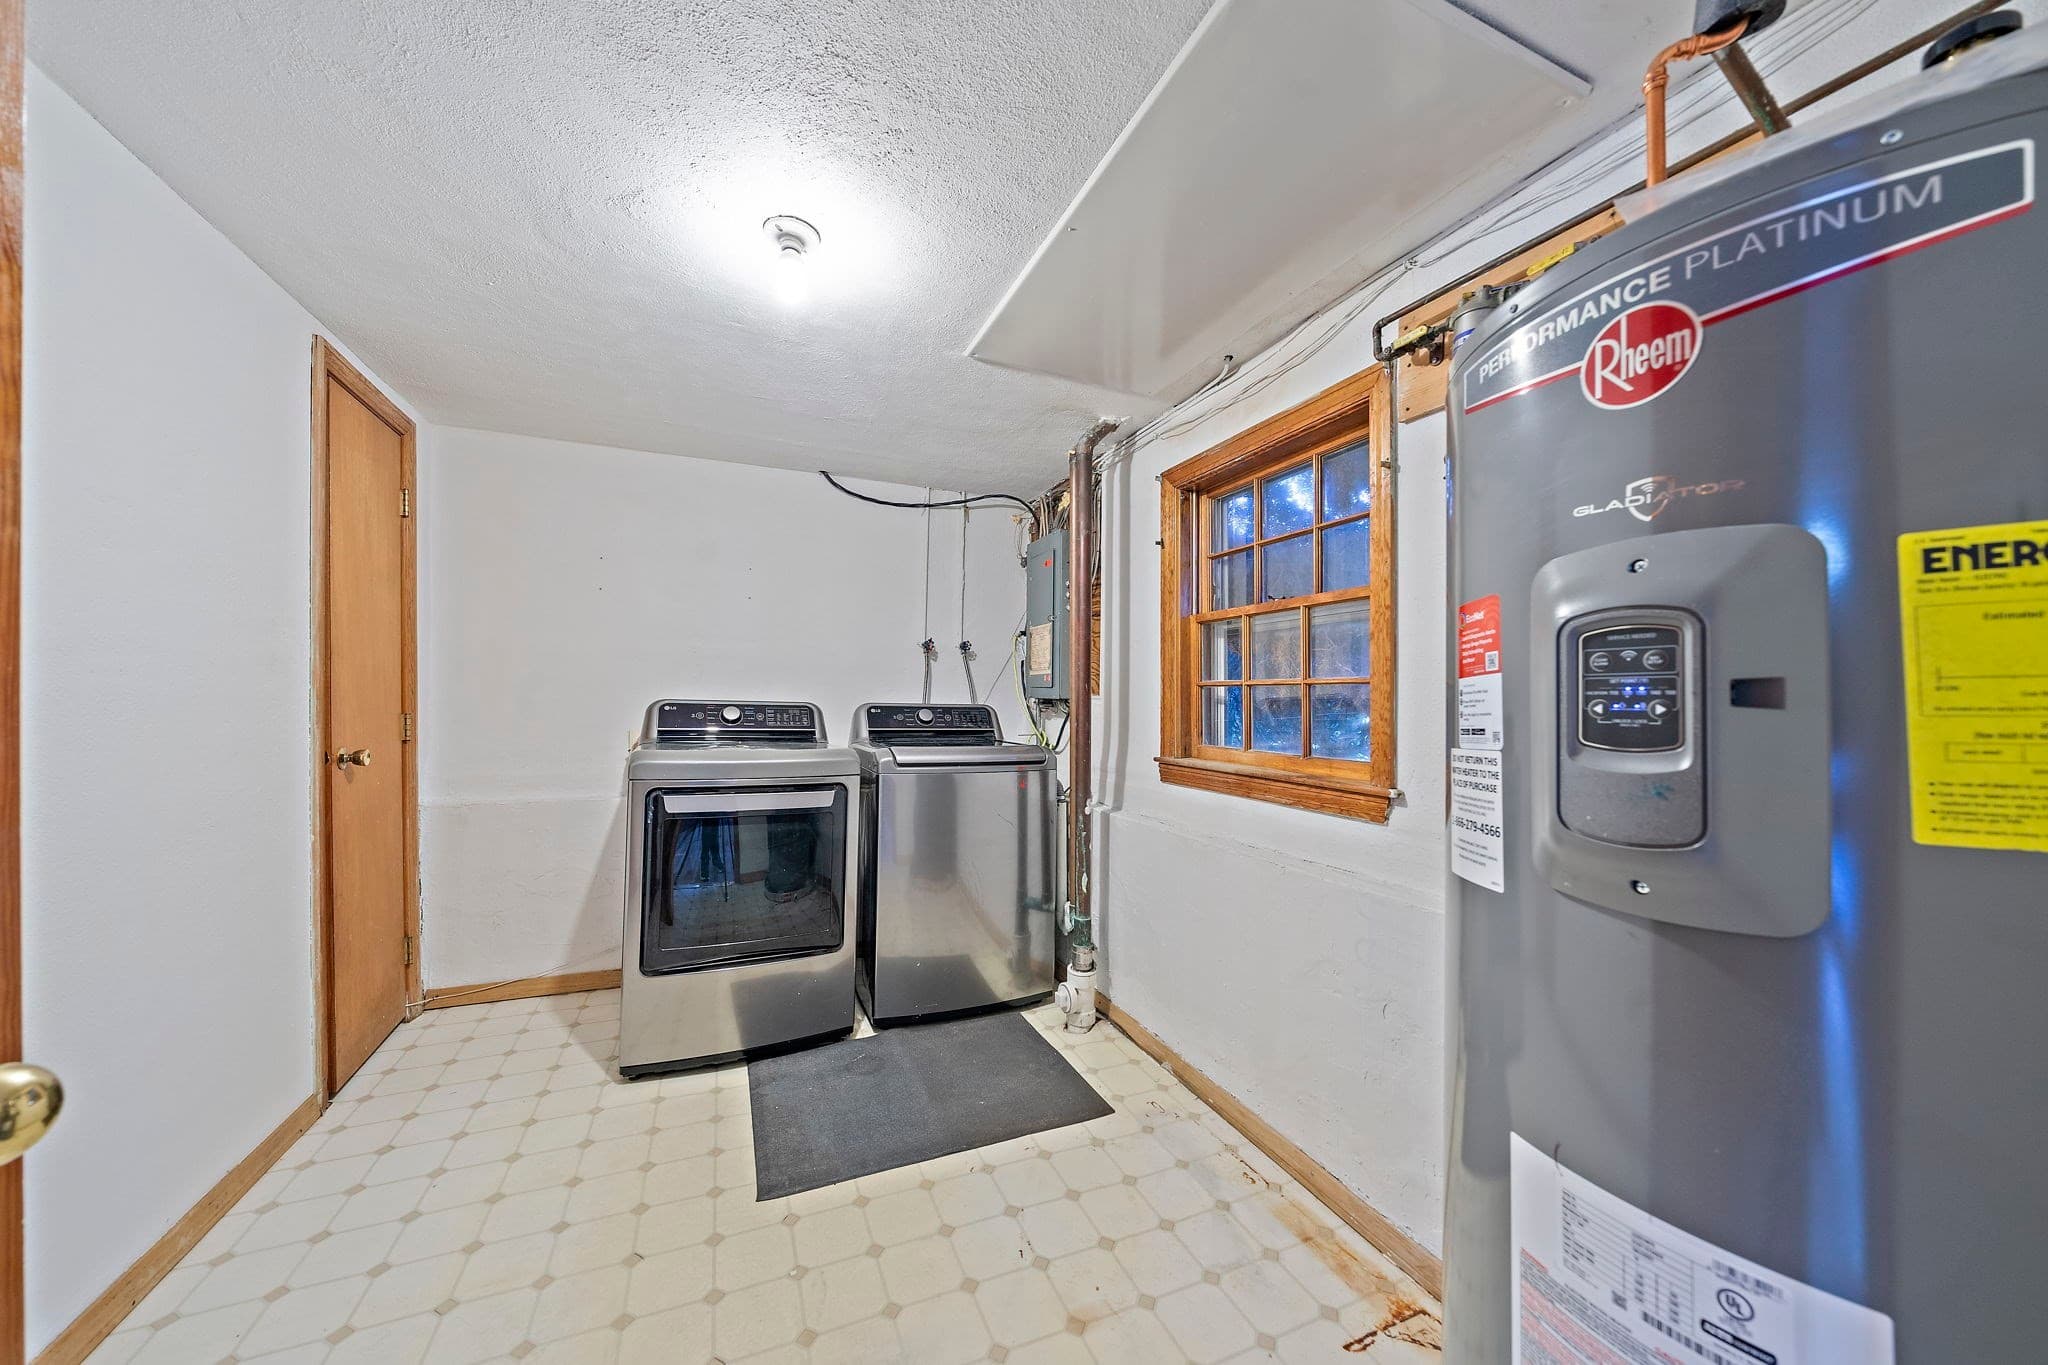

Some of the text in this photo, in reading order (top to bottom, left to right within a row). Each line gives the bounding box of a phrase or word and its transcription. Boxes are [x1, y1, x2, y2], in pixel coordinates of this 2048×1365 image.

[1685, 174, 1942, 280] PLATINUM
[1594, 314, 1691, 399] Rheem
[1572, 479, 1746, 517] GLADIATOR
[1463, 768, 1478, 777] HEATER
[1479, 769, 1486, 779] TO
[1487, 770, 1499, 780] THE
[1465, 756, 1483, 765] RETURN
[1484, 757, 1498, 767] THIS
[1469, 781, 1497, 793] PURCHASE
